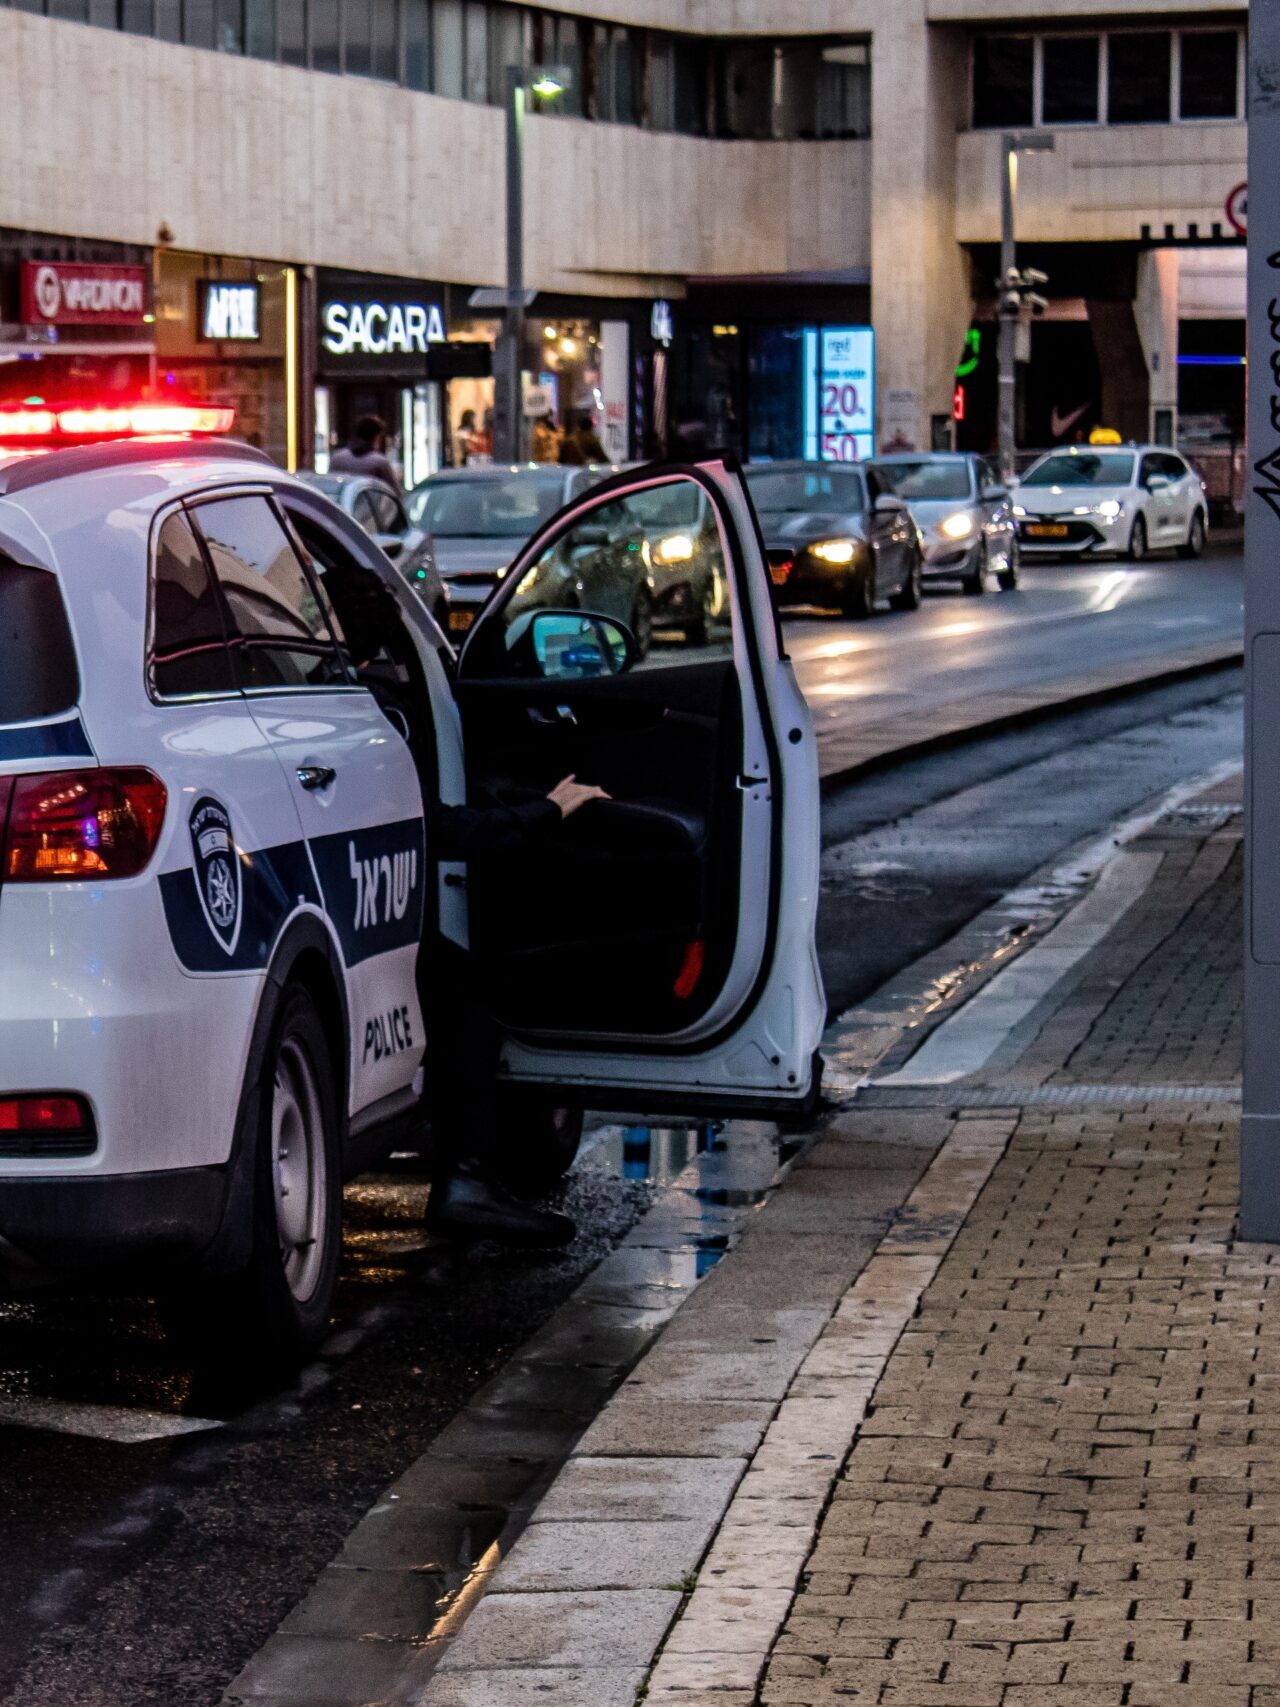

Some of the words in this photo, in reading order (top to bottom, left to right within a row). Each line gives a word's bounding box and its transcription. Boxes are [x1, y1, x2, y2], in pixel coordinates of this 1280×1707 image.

[323, 302, 445, 353] SACARA
[348, 840, 417, 931] ישראל
[362, 1006, 413, 1066] POLICE
